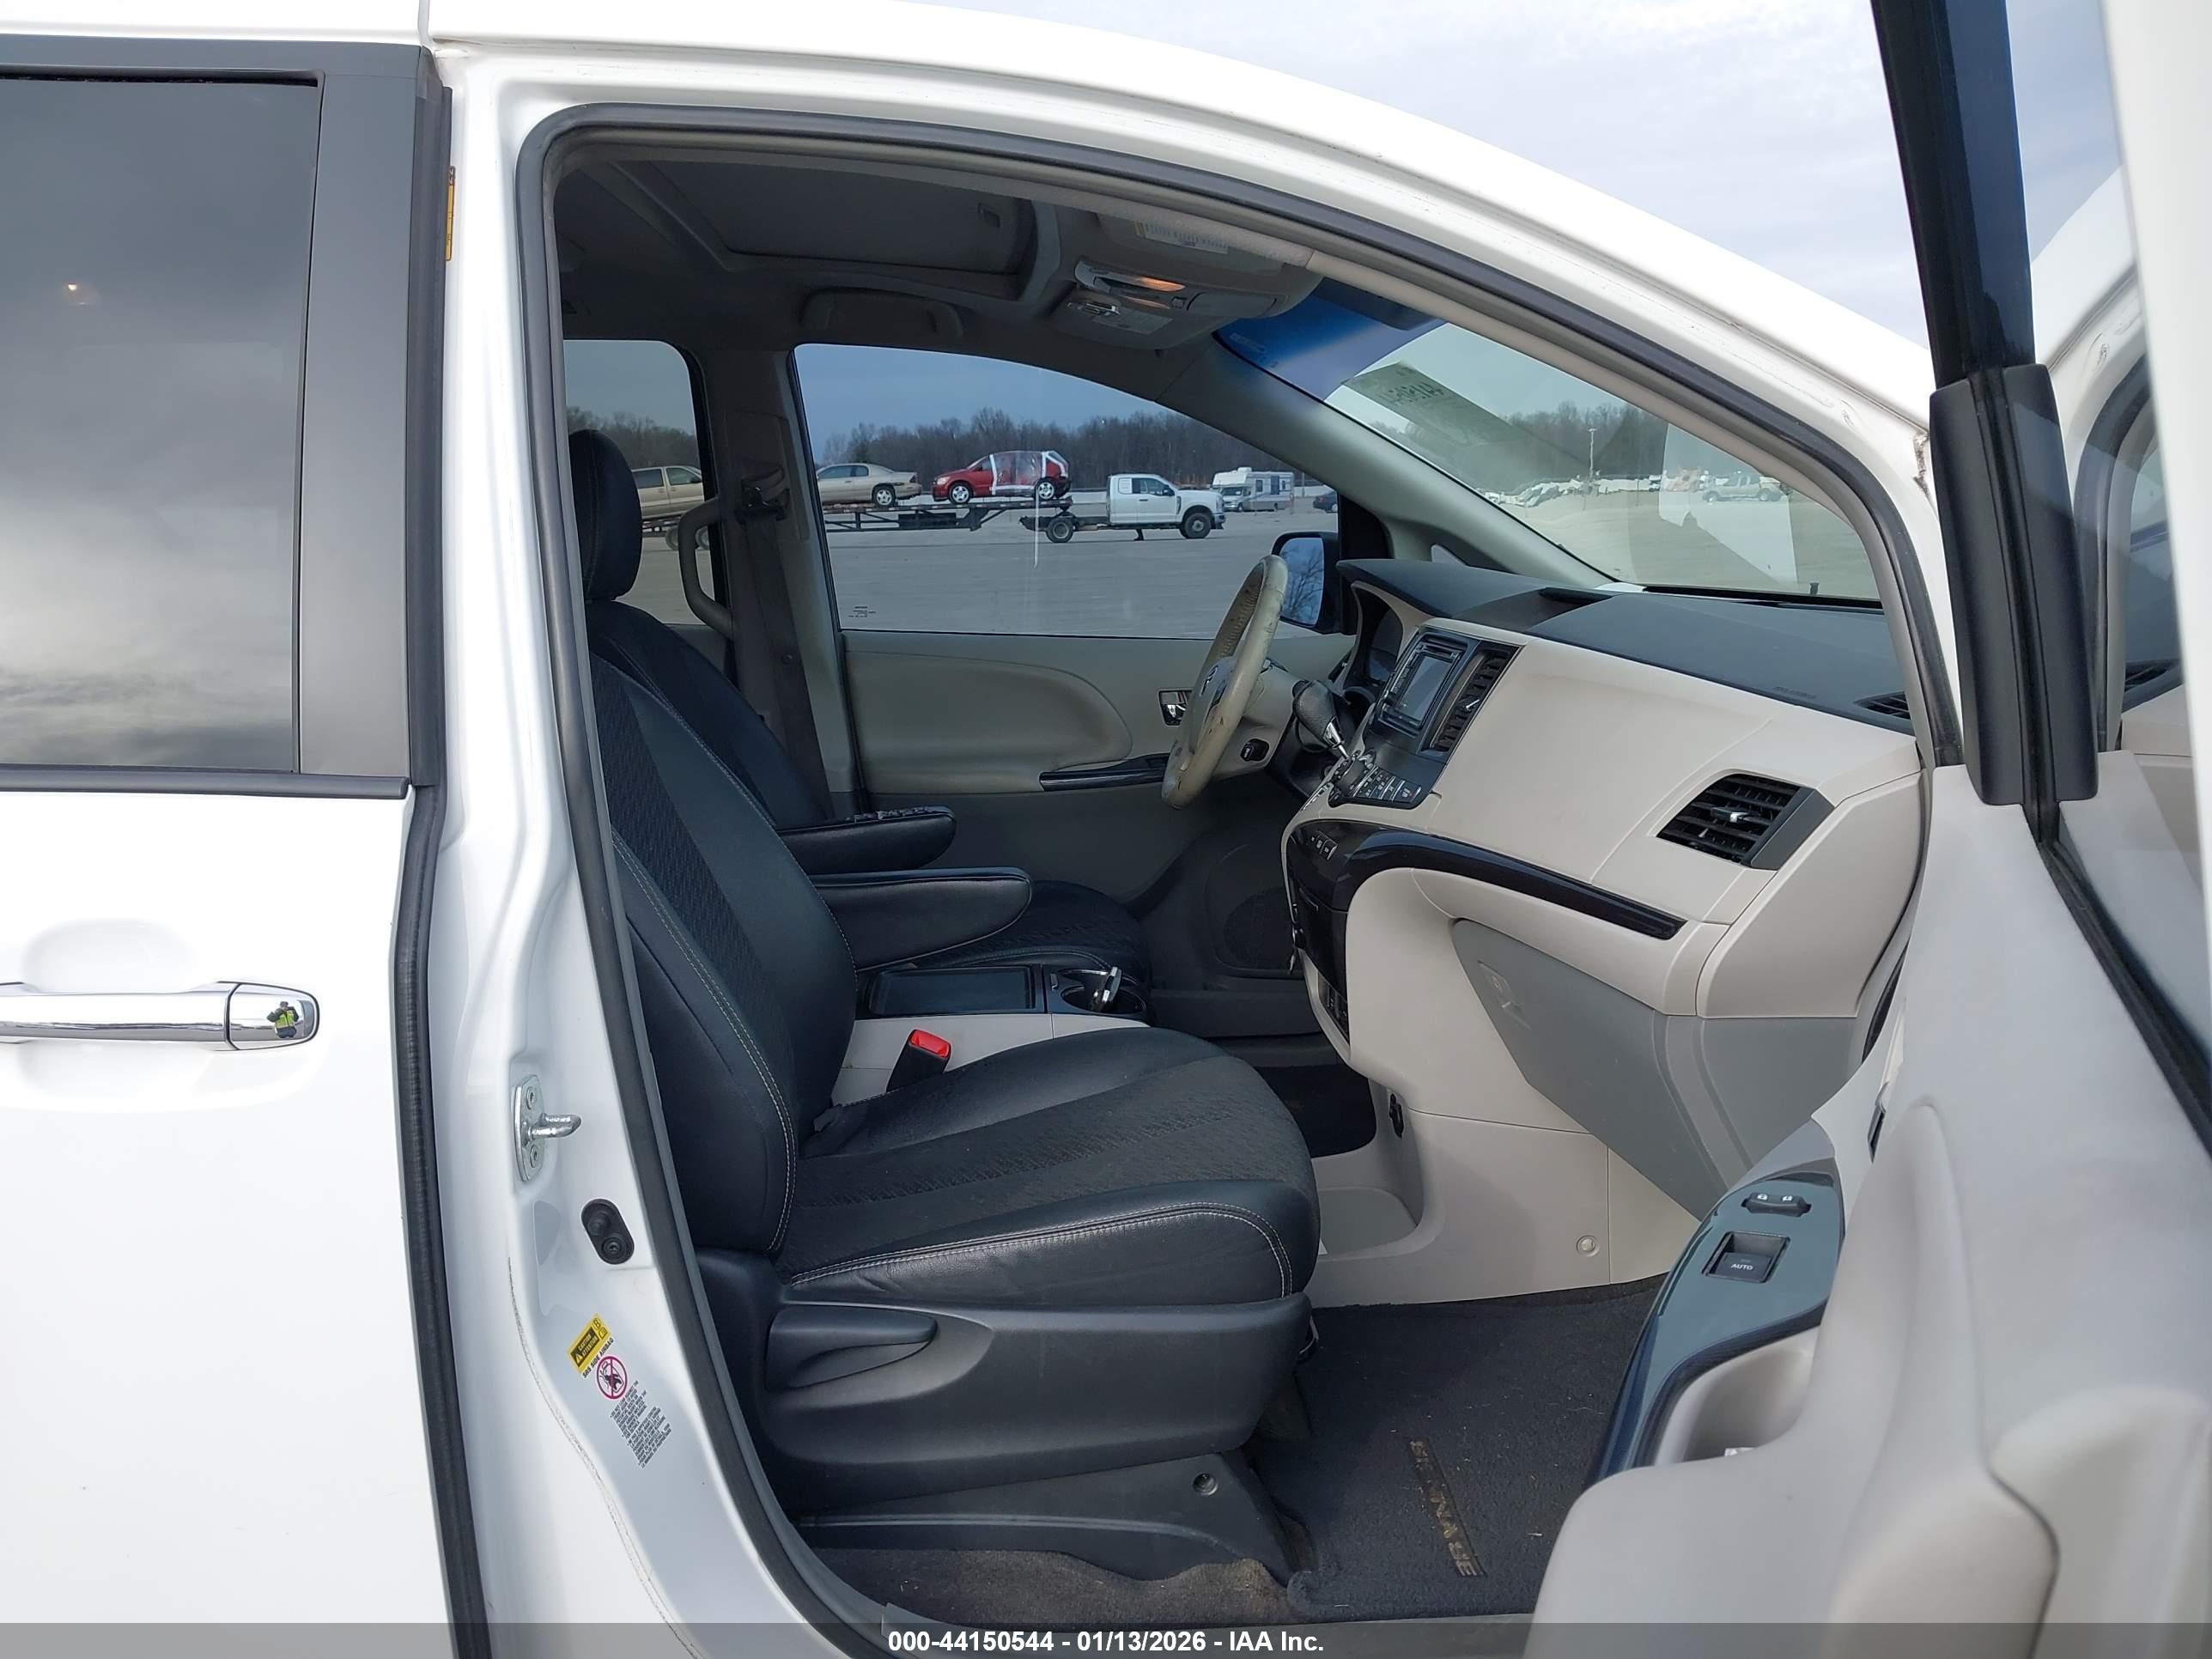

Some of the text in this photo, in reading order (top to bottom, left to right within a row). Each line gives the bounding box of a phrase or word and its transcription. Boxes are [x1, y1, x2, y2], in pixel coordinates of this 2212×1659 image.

[578, 1334, 592, 1352] CAUTION
[590, 1354, 600, 1369] SIDE
[599, 1337, 614, 1357] AIRBAG
